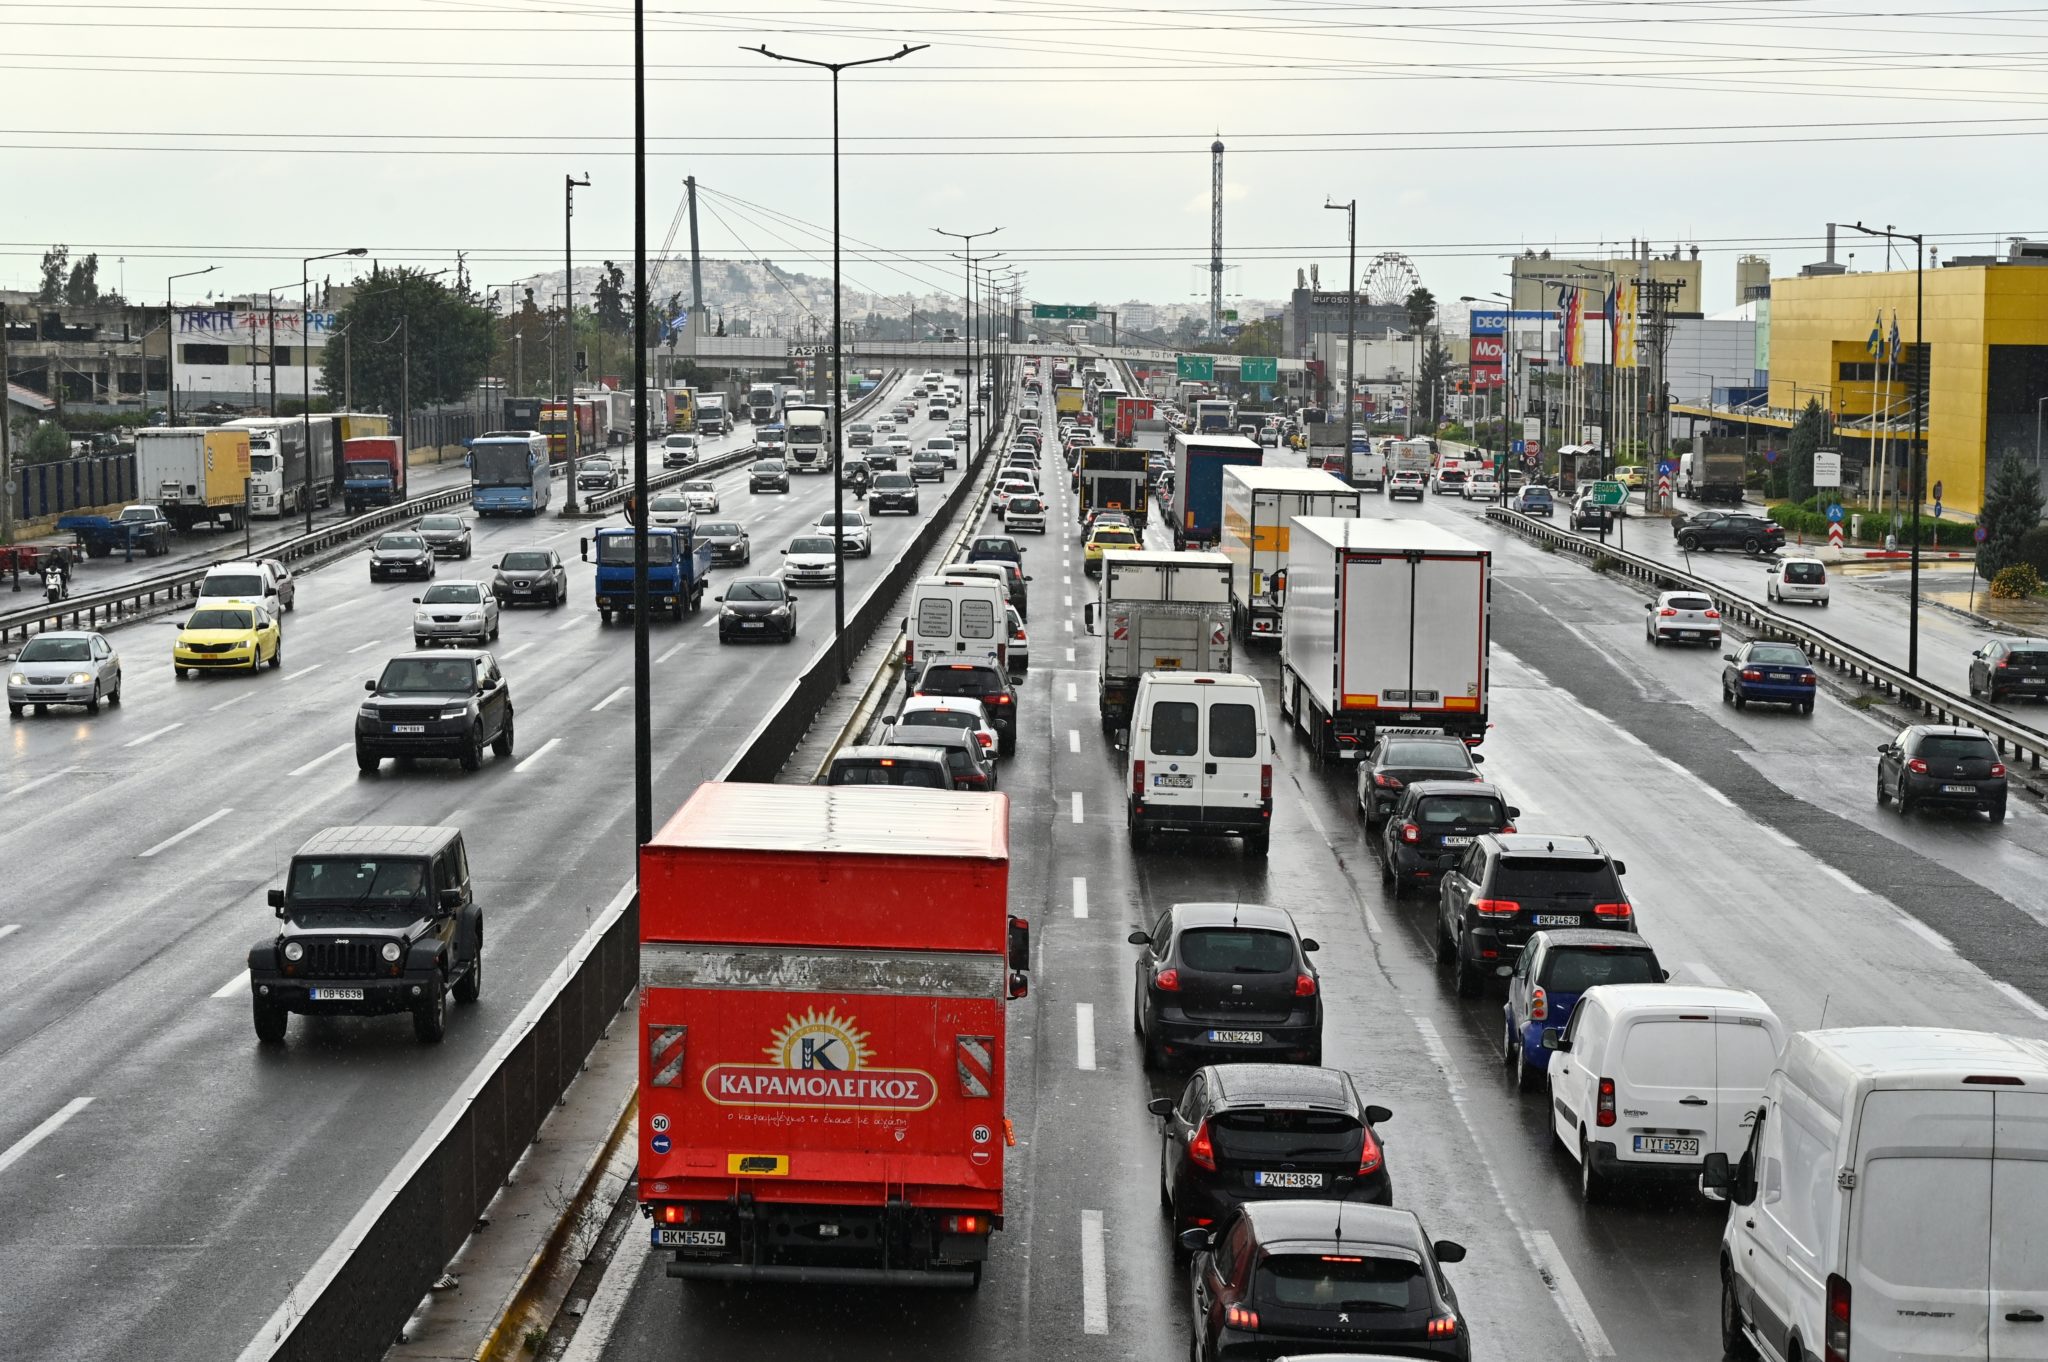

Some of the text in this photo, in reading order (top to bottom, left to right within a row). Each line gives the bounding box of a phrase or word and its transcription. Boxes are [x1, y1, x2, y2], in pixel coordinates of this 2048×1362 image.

[1313, 296, 1360, 304] eurosoa
[1594, 484, 1618, 492] ΕΞΟΔΟΣ
[1381, 728, 1439, 736] LAMBERET
[720, 1075, 920, 1100] ΚΑΡΑΜΟΛΕΓΚΟΣ
[654, 1118, 667, 1129] 90
[974, 1130, 987, 1140] 80
[1896, 1310, 1955, 1318] TRANSIT
